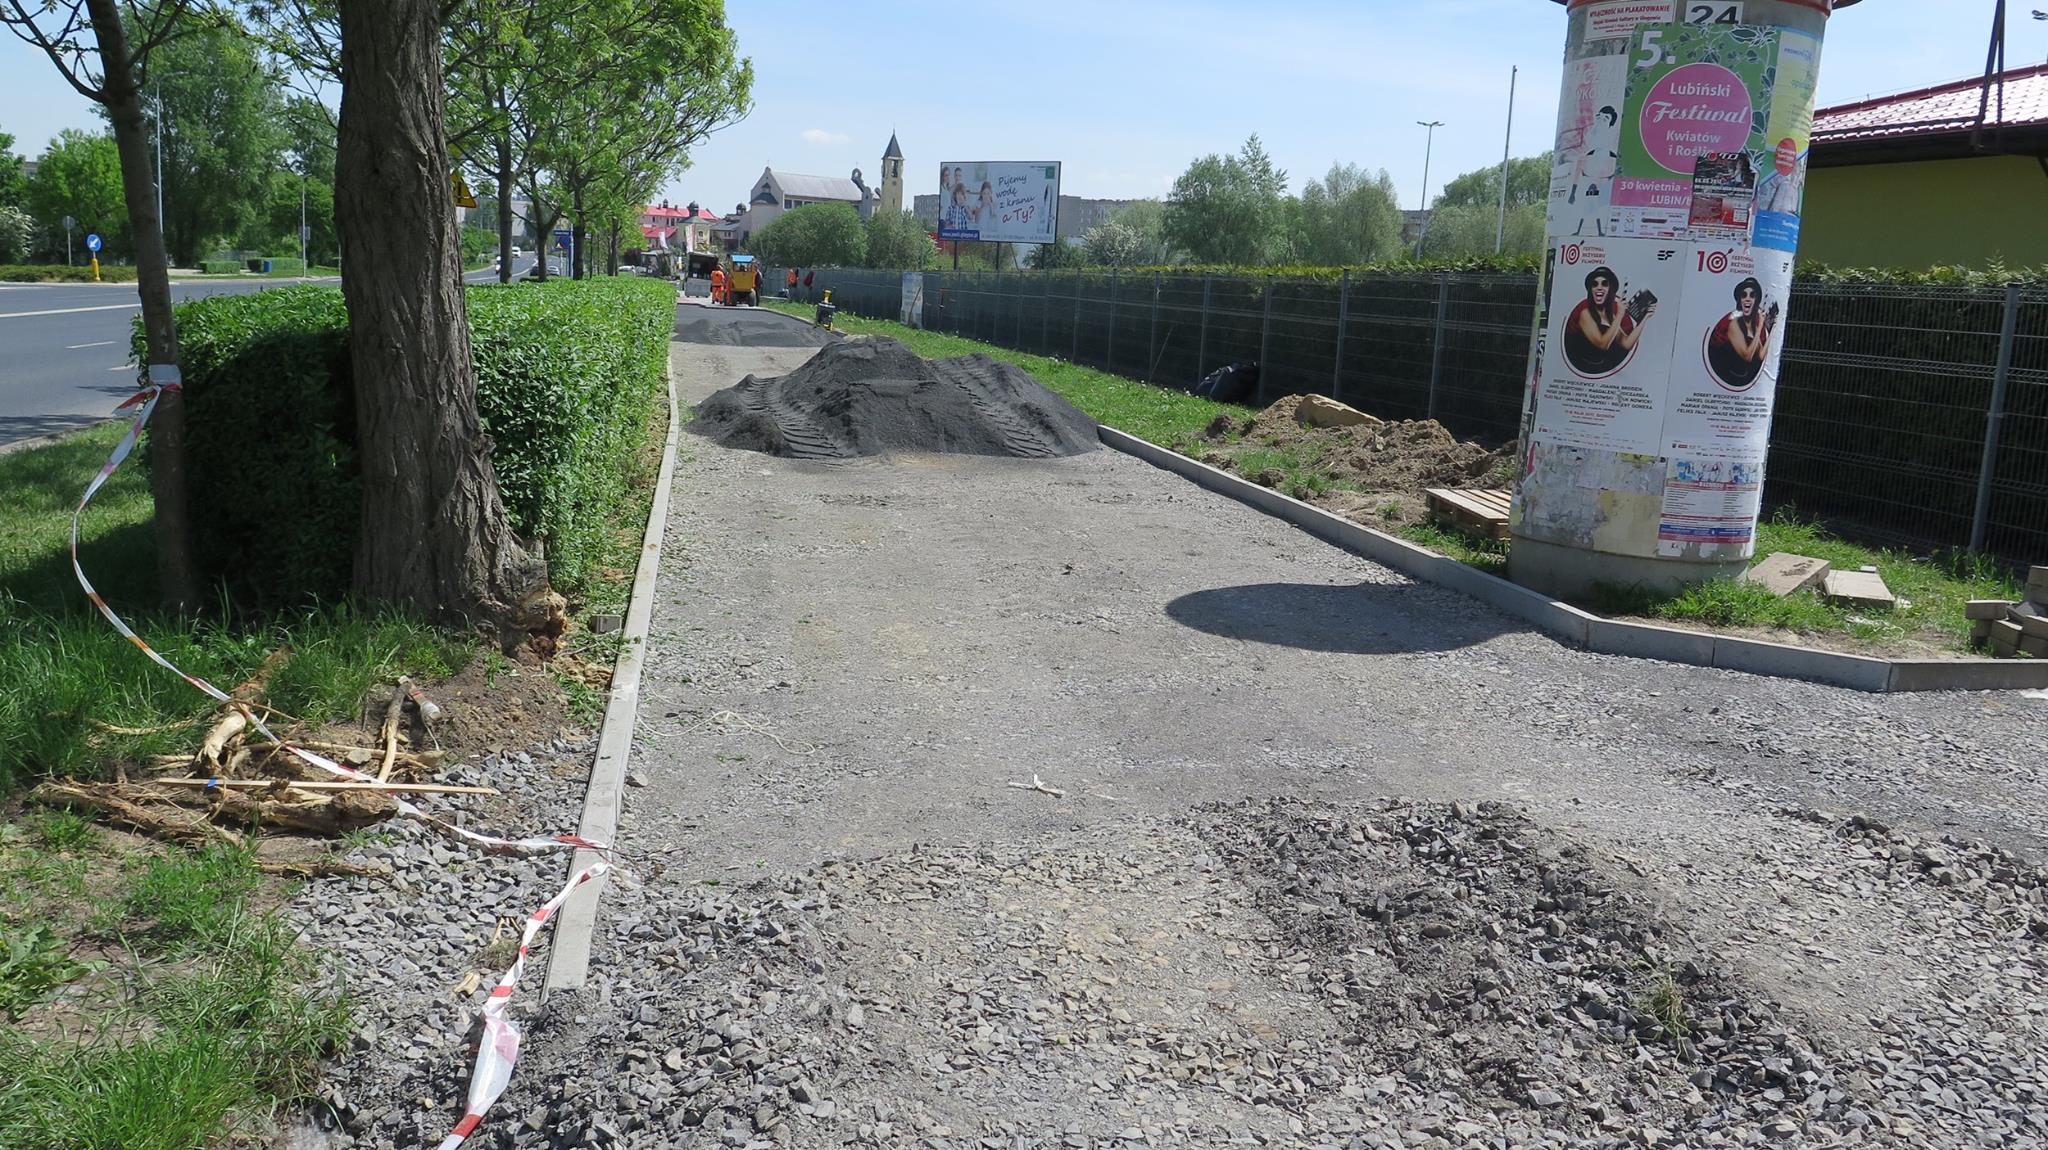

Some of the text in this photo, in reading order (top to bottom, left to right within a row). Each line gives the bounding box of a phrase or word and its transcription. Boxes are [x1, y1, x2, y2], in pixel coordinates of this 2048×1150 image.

[1691, 5, 1738, 25] 24
[1636, 30, 1676, 68] 5.
[1670, 82, 1731, 97] Lubiński
[1645, 101, 1749, 124] Festiwal
[1666, 130, 1721, 144] Kwiatów
[998, 174, 1027, 187] Pijemy
[1620, 181, 1634, 191] 30
[1636, 180, 1681, 192] kwietnia
[1002, 205, 1035, 223] a Ty?
[1561, 244, 1580, 265] 10
[1697, 251, 1728, 273] 10
